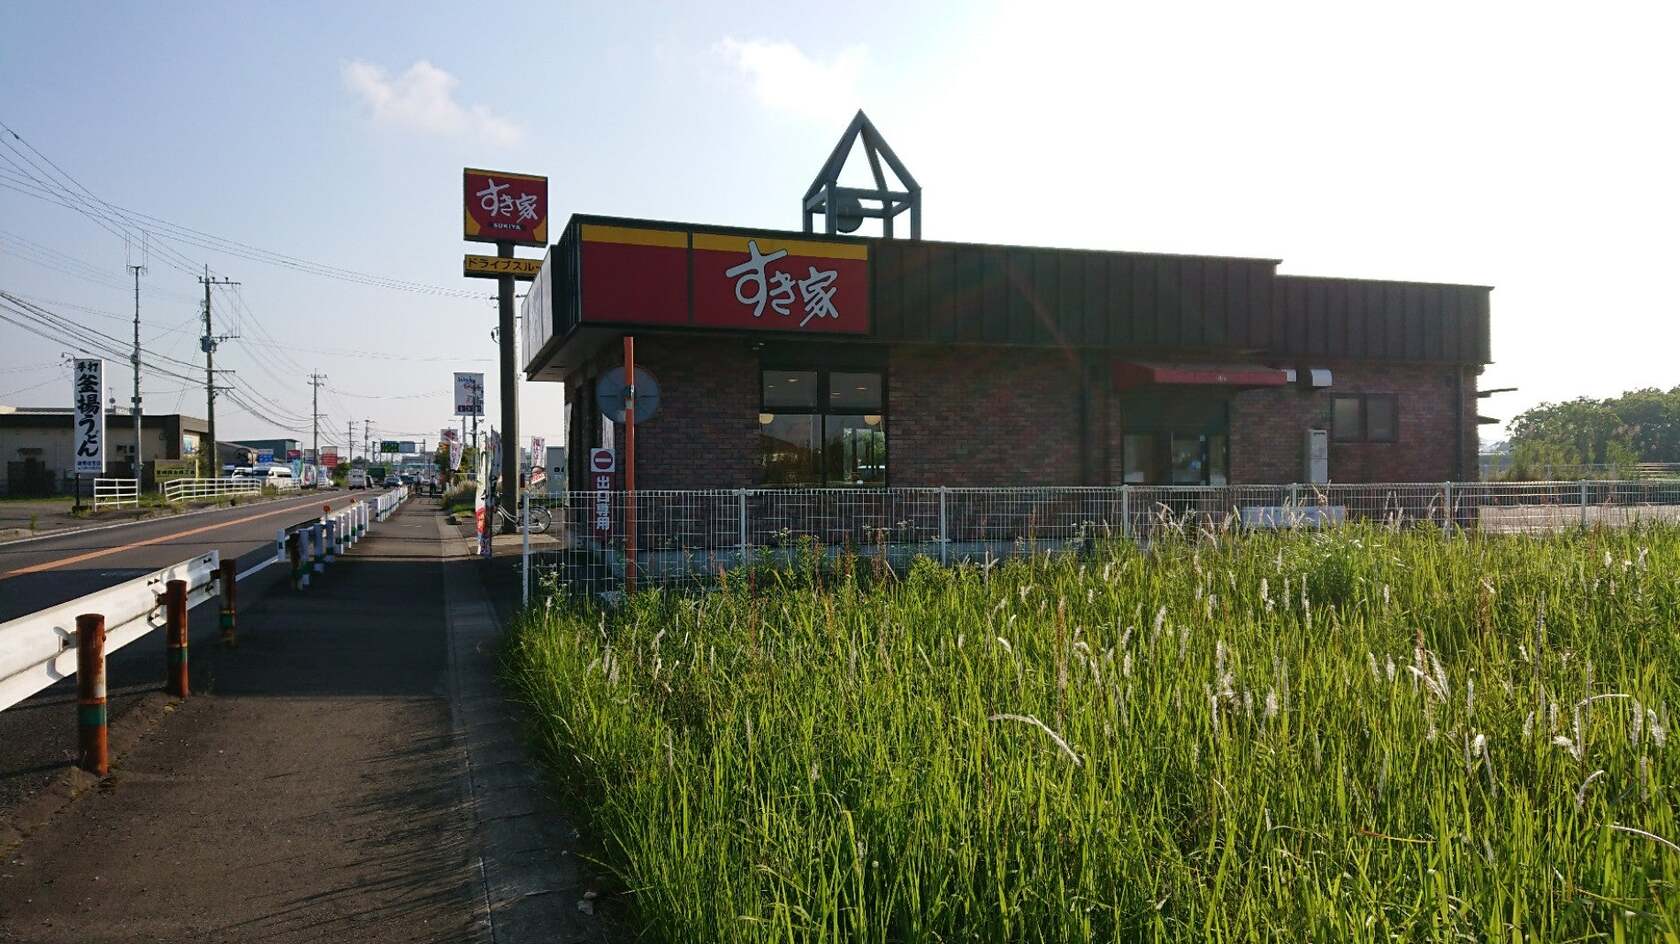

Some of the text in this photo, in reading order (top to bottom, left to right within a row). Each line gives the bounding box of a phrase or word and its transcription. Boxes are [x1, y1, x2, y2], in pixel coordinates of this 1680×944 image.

[476, 178, 538, 223] すき家
[493, 222, 521, 230] SUKIYA
[725, 239, 840, 327] すき家
[76, 361, 98, 372] 手打
[77, 373, 100, 457] 釜揚うどん
[596, 475, 610, 530] 出口専用
